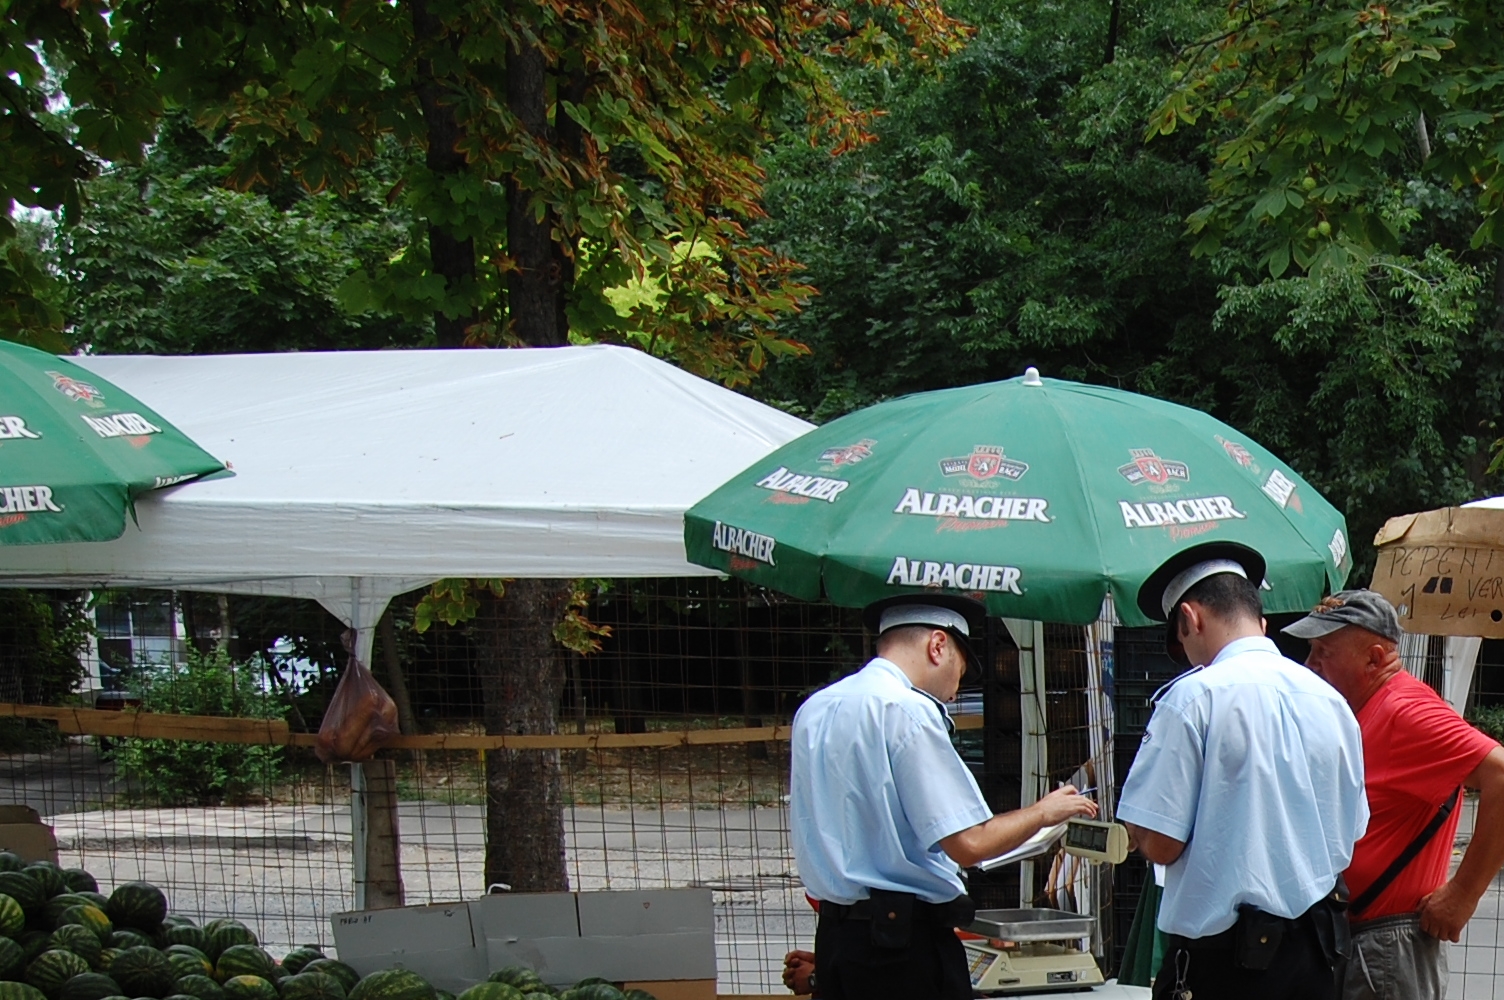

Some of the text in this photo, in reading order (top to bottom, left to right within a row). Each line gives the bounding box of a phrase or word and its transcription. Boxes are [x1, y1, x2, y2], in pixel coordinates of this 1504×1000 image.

[755, 466, 851, 503] ALBACHER
[894, 487, 1050, 523] ALBACHER
[1118, 496, 1246, 528] ALBACHER
[713, 521, 777, 567] ALBACHER
[886, 557, 1027, 595] ALBACHER
